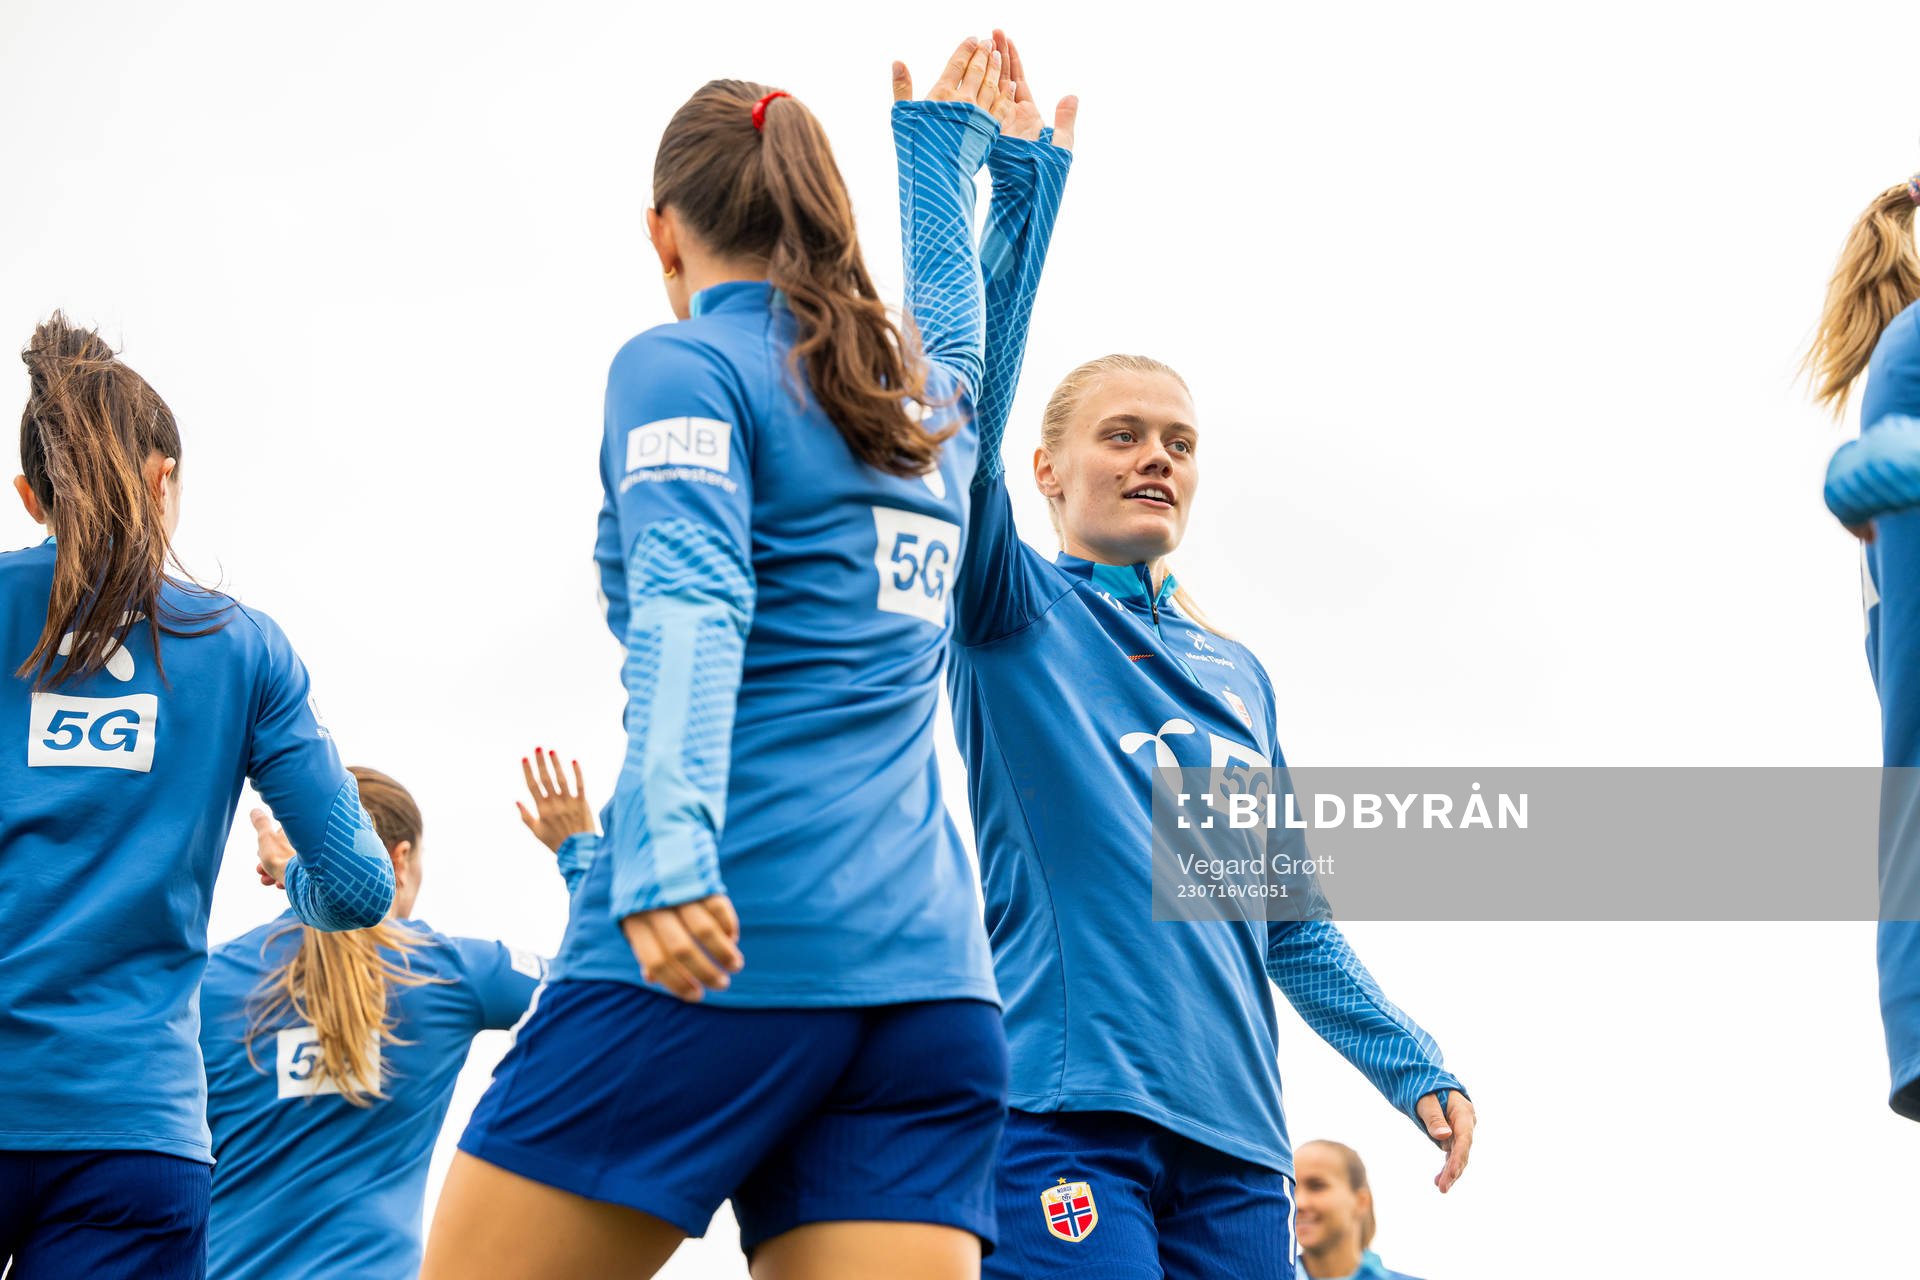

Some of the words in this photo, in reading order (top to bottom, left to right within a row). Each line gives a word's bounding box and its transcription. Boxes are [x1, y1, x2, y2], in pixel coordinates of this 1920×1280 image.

[640, 416, 717, 464] DNB
[891, 532, 949, 600] 5G
[42, 708, 140, 752] 5G
